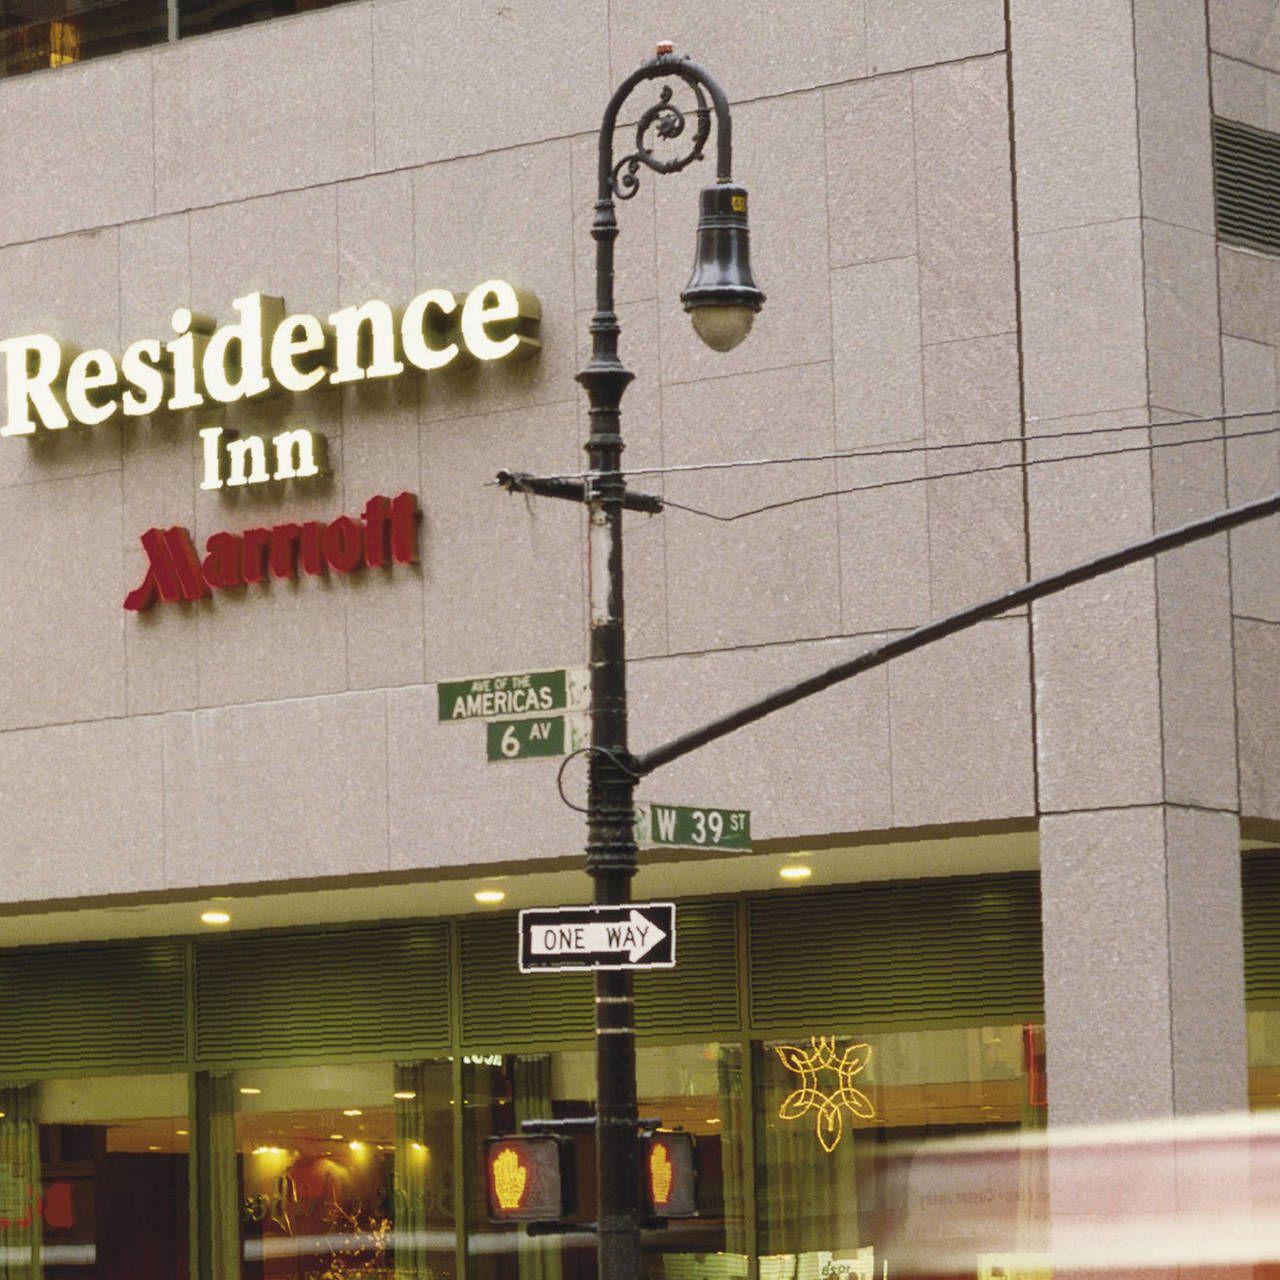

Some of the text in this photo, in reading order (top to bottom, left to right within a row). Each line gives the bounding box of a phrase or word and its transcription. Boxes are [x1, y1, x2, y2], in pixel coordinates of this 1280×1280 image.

[199, 426, 324, 490] Inn
[123, 491, 422, 611] Marriott
[470, 675, 532, 692] AVE OF THE
[452, 685, 553, 719] AMERICAS
[501, 722, 552, 758] 6 AV
[656, 807, 746, 844] W 39 ST
[544, 925, 650, 951] ONE WAY
